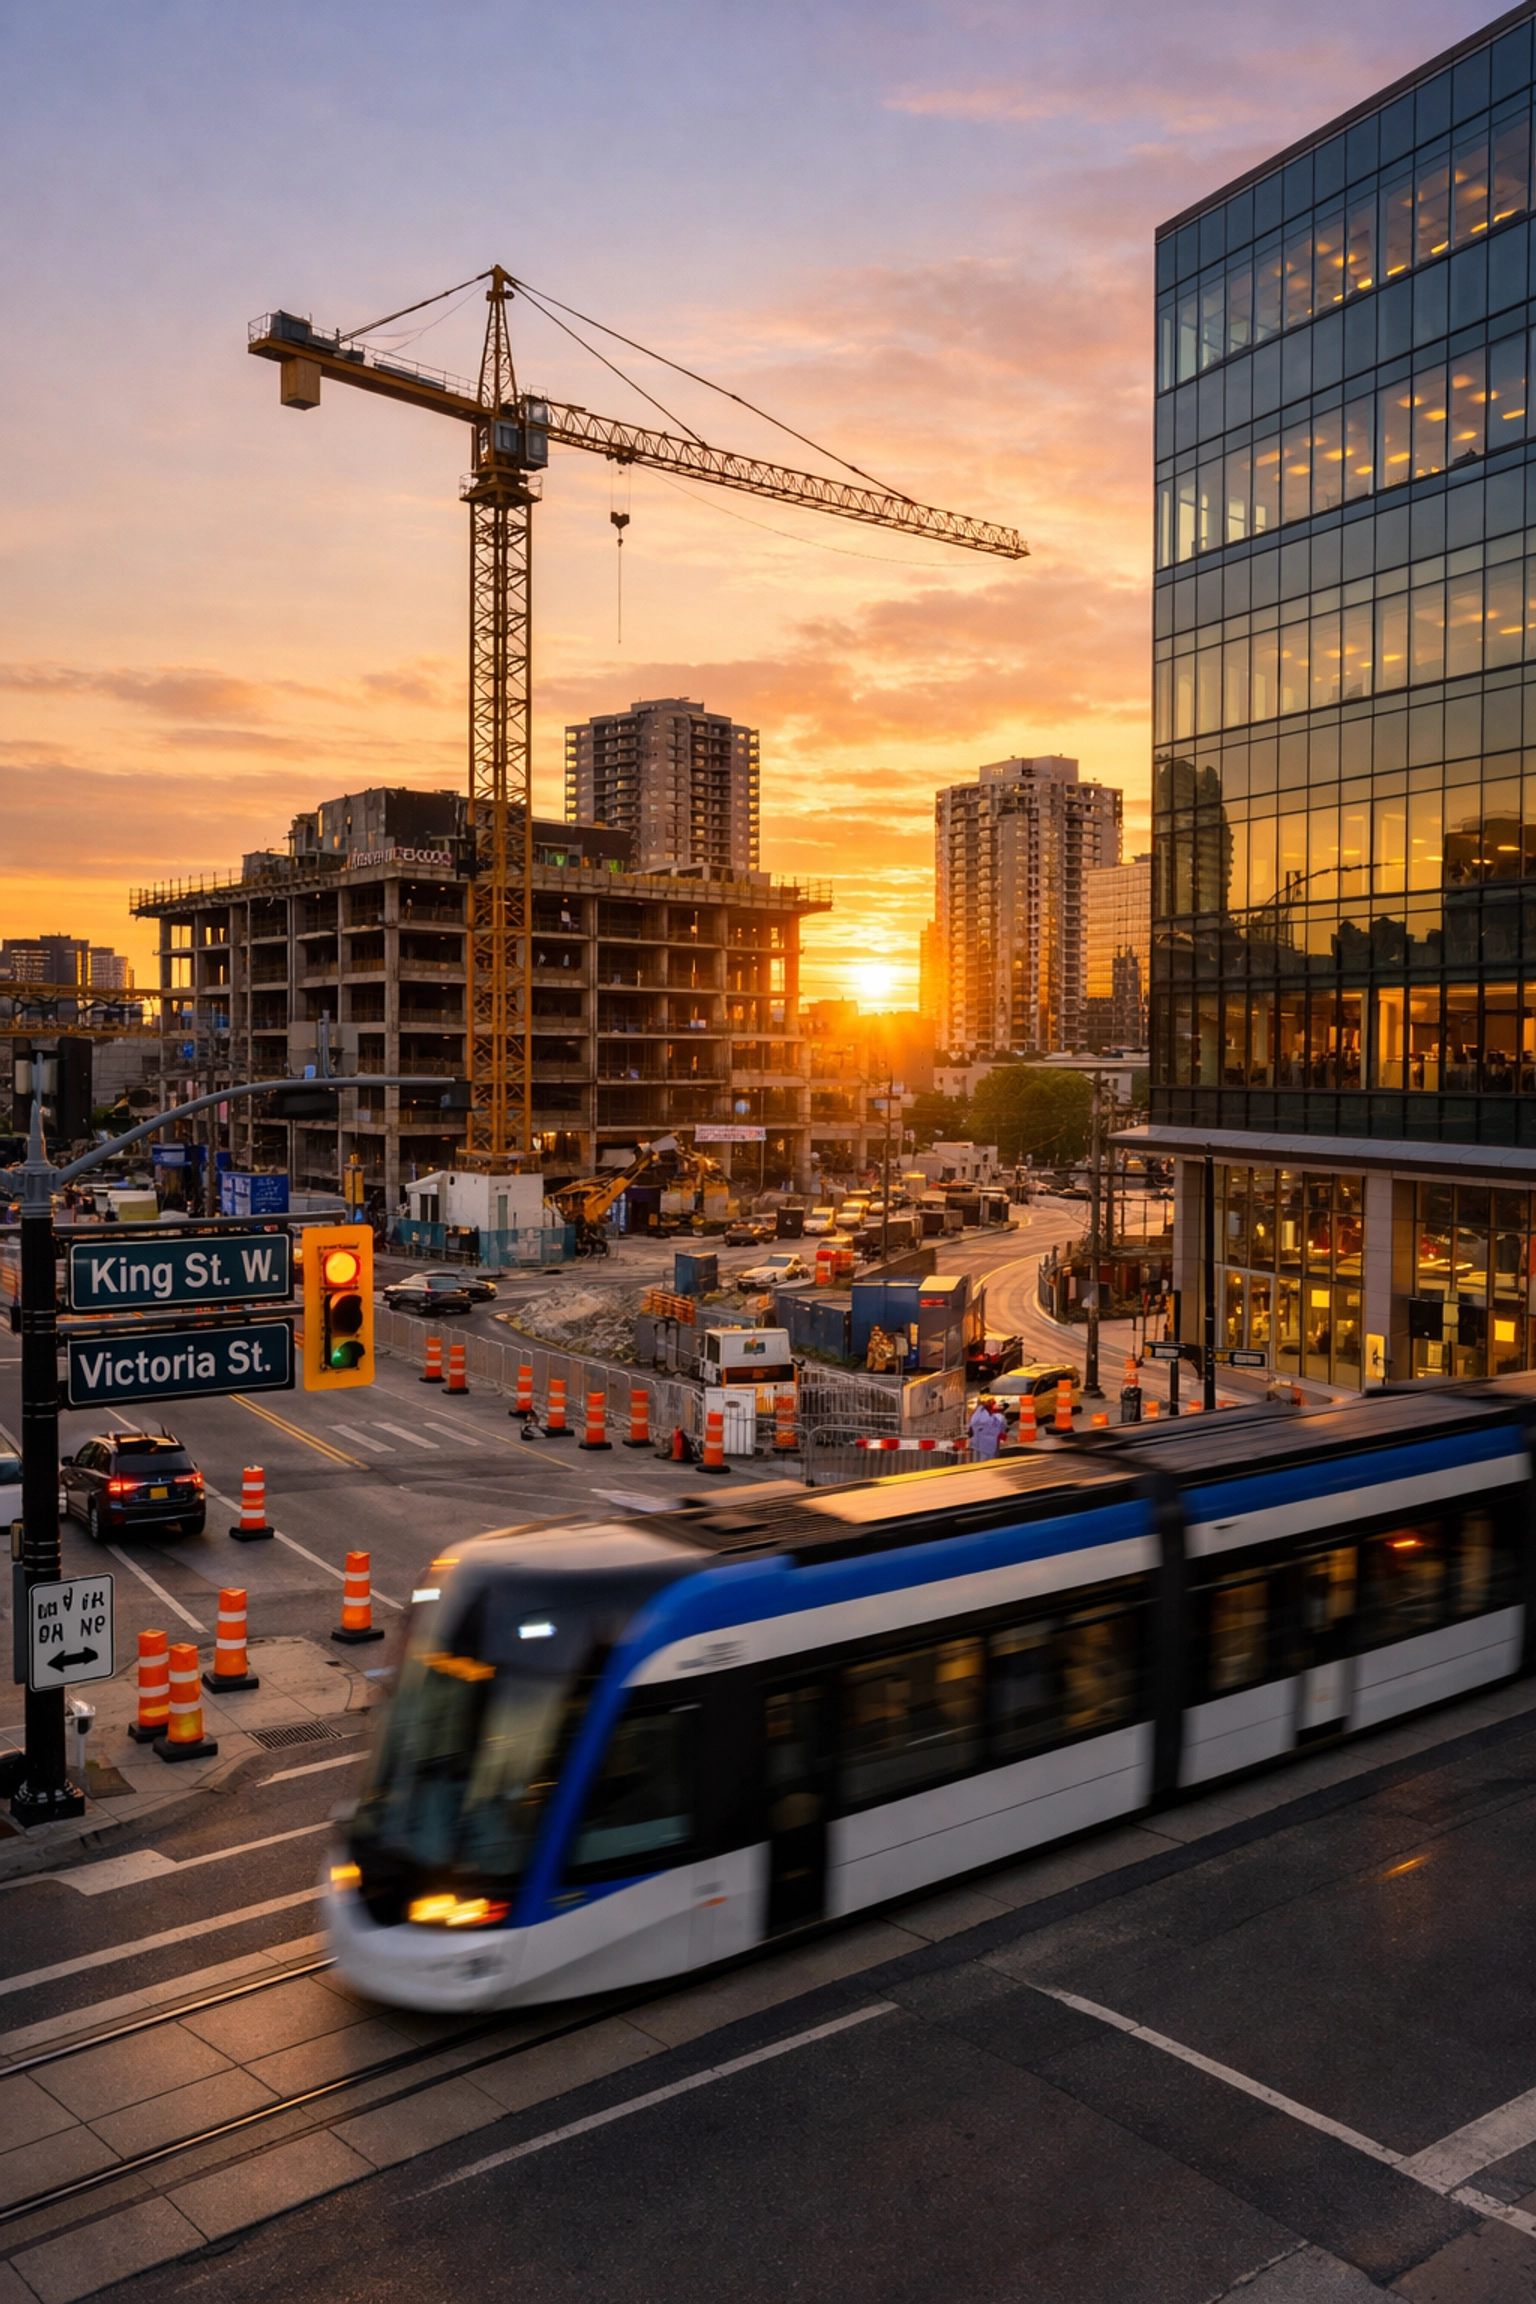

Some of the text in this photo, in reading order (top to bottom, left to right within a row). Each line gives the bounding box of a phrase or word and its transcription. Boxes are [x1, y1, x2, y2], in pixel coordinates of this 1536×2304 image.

[91, 1249, 279, 1298] King St. W.
[78, 1341, 271, 1389] Victoria St.
